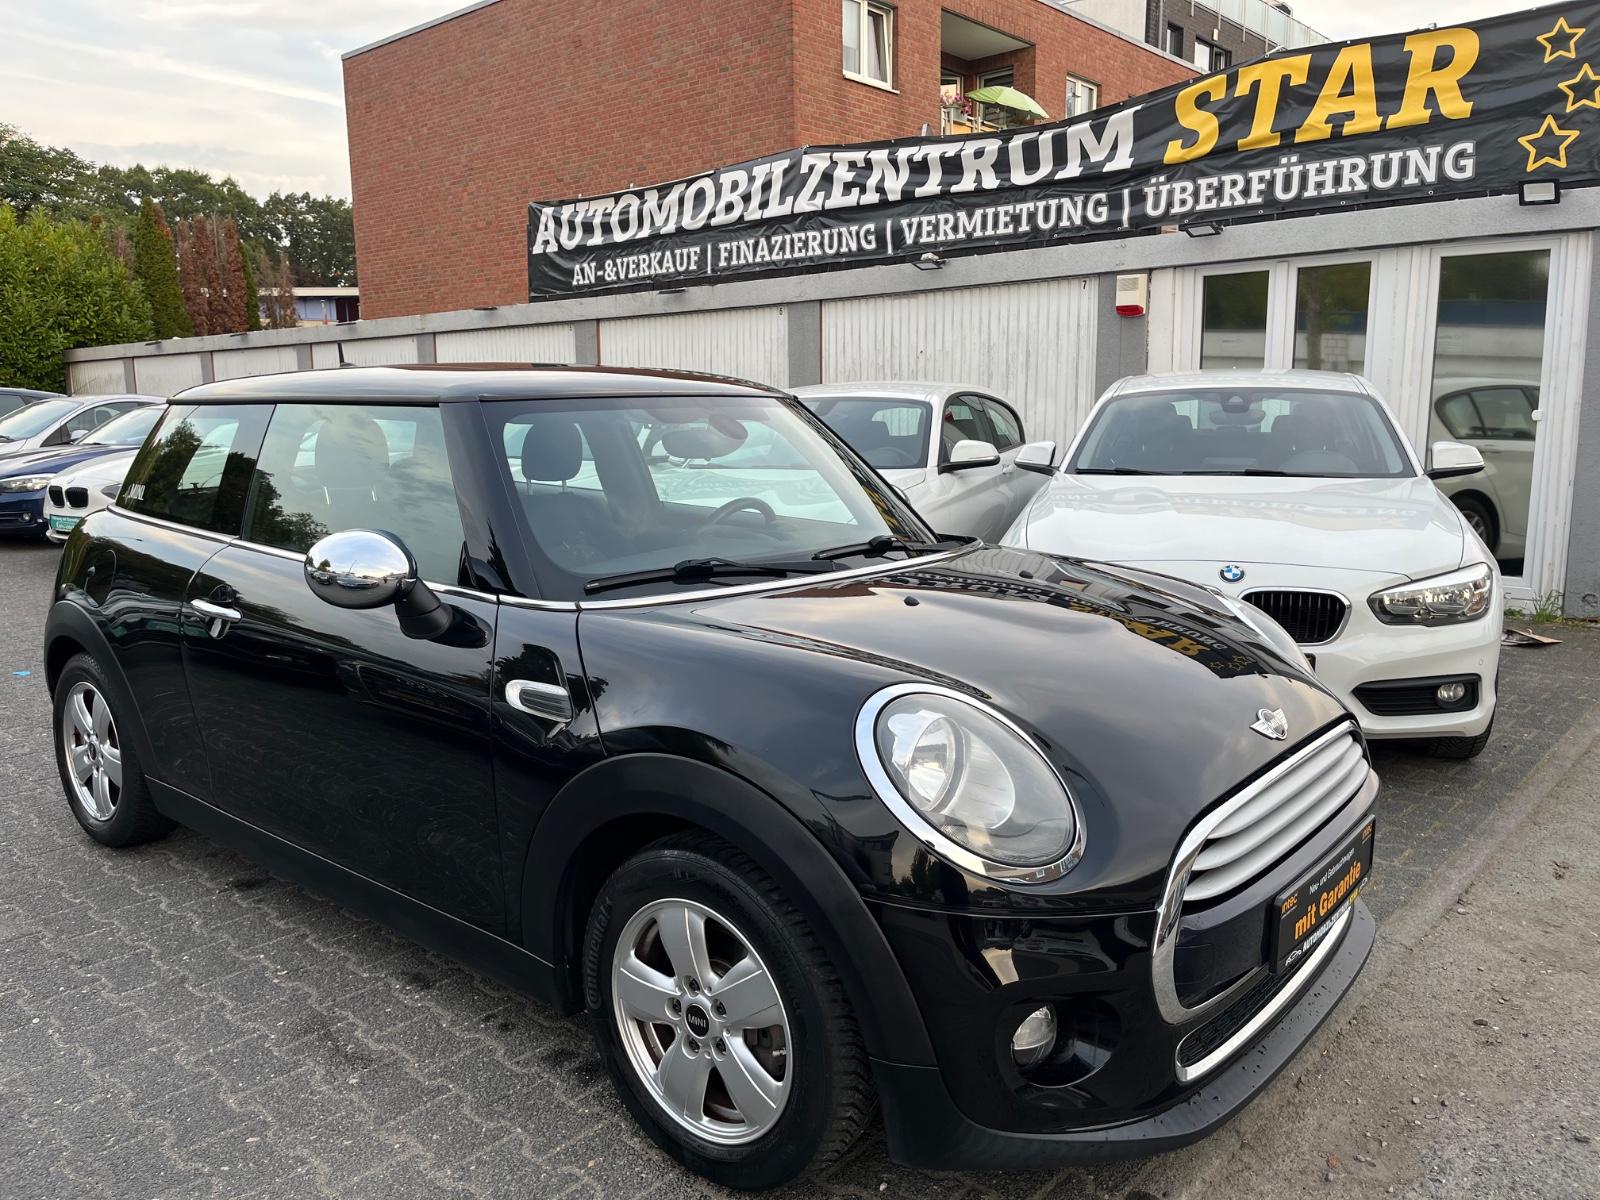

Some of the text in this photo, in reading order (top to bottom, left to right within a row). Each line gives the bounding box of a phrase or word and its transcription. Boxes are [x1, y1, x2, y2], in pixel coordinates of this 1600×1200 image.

[533, 28, 1480, 254] AUTOMOBILZENTRUM STAR
[572, 247, 700, 286] AN-&VERKAUF
[718, 224, 877, 267] FINAZIERUNG
[901, 193, 1109, 245] VERMIETUNG
[1144, 142, 1476, 217] ÜBERFÜHRUNG
[1281, 890, 1298, 914] intec
[1294, 860, 1361, 940] mit Garantie
[687, 1013, 706, 1028] MINI
